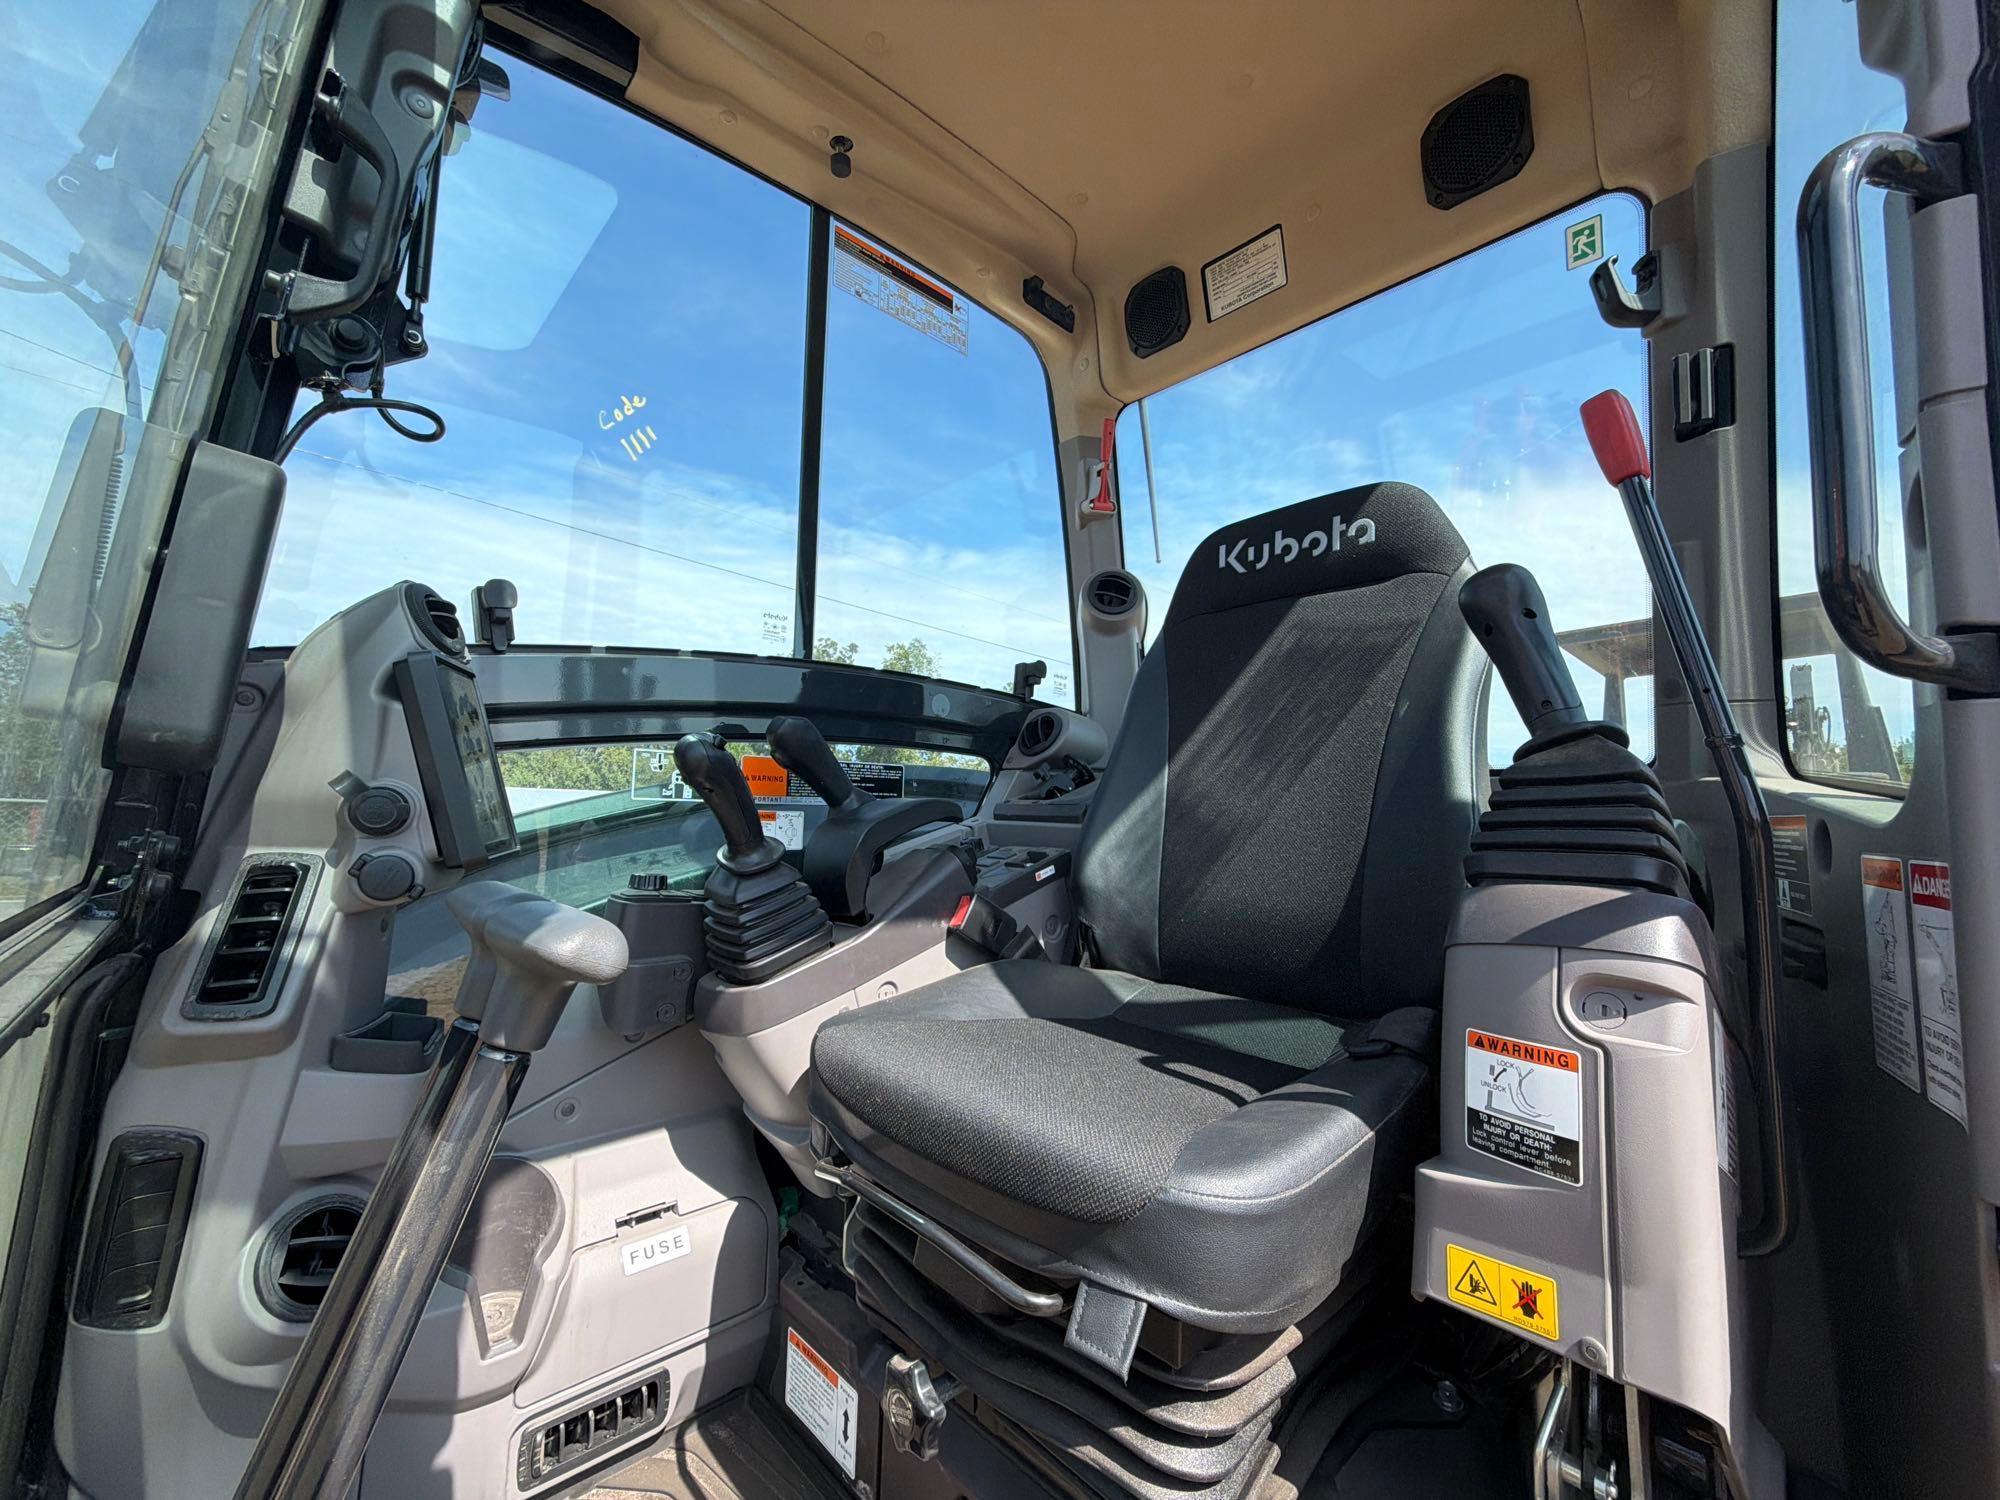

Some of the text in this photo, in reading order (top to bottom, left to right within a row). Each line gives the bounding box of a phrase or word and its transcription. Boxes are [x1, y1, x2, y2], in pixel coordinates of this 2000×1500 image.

[599, 394, 647, 430] Code
[620, 425, 658, 461] 1111
[1218, 515, 1376, 574] Kubota
[751, 774, 784, 783] WARNING
[1487, 1037, 1569, 1068] WARNING
[1496, 1059, 1515, 1070] LOCK
[1480, 1080, 1507, 1094] UNLOCK
[1479, 1113, 1556, 1144] TO AVOID PERSONAL
[1483, 1123, 1553, 1152] INJURY OR DEATH:
[1472, 1126, 1572, 1167] Lock control lever before
[1472, 1135, 1552, 1169] leaving compartment.
[630, 1235, 684, 1265] FUSE
